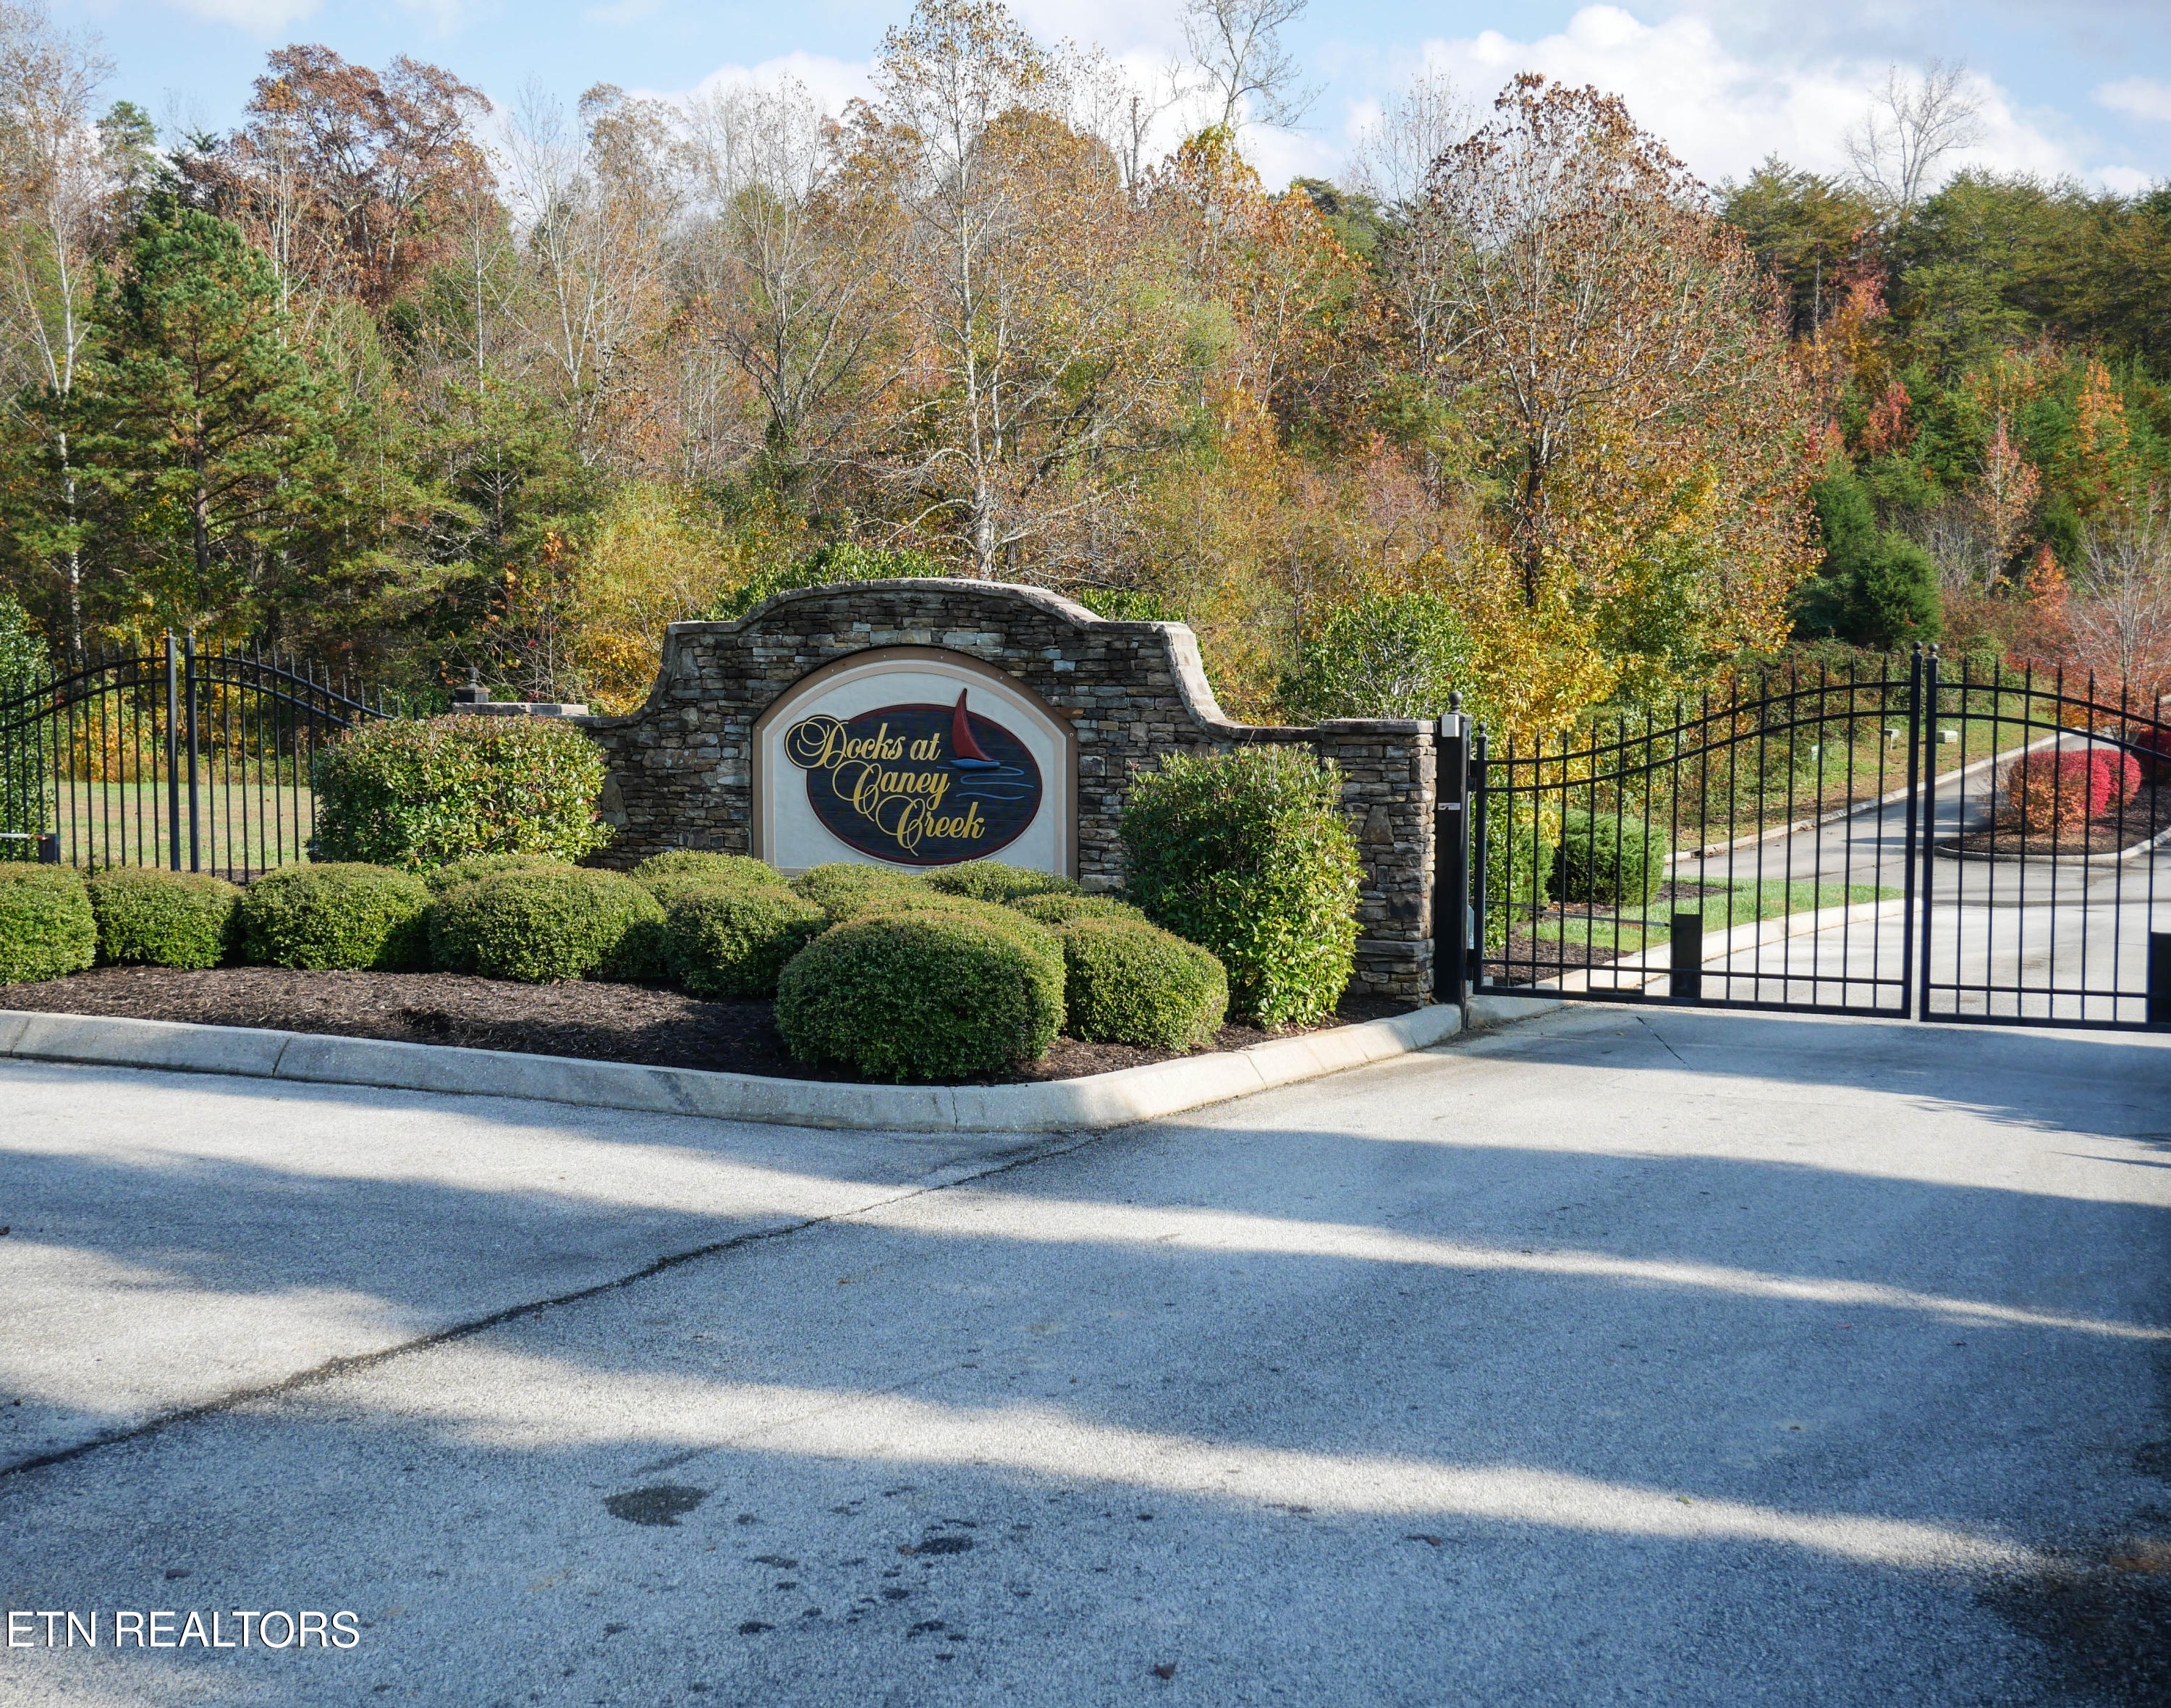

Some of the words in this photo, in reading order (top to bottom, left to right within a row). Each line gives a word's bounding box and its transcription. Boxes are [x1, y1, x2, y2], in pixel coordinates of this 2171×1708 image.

[785, 716, 905, 769] Docks
[910, 732, 941, 761] at
[833, 760, 950, 821] Caney
[876, 795, 986, 857] Creek
